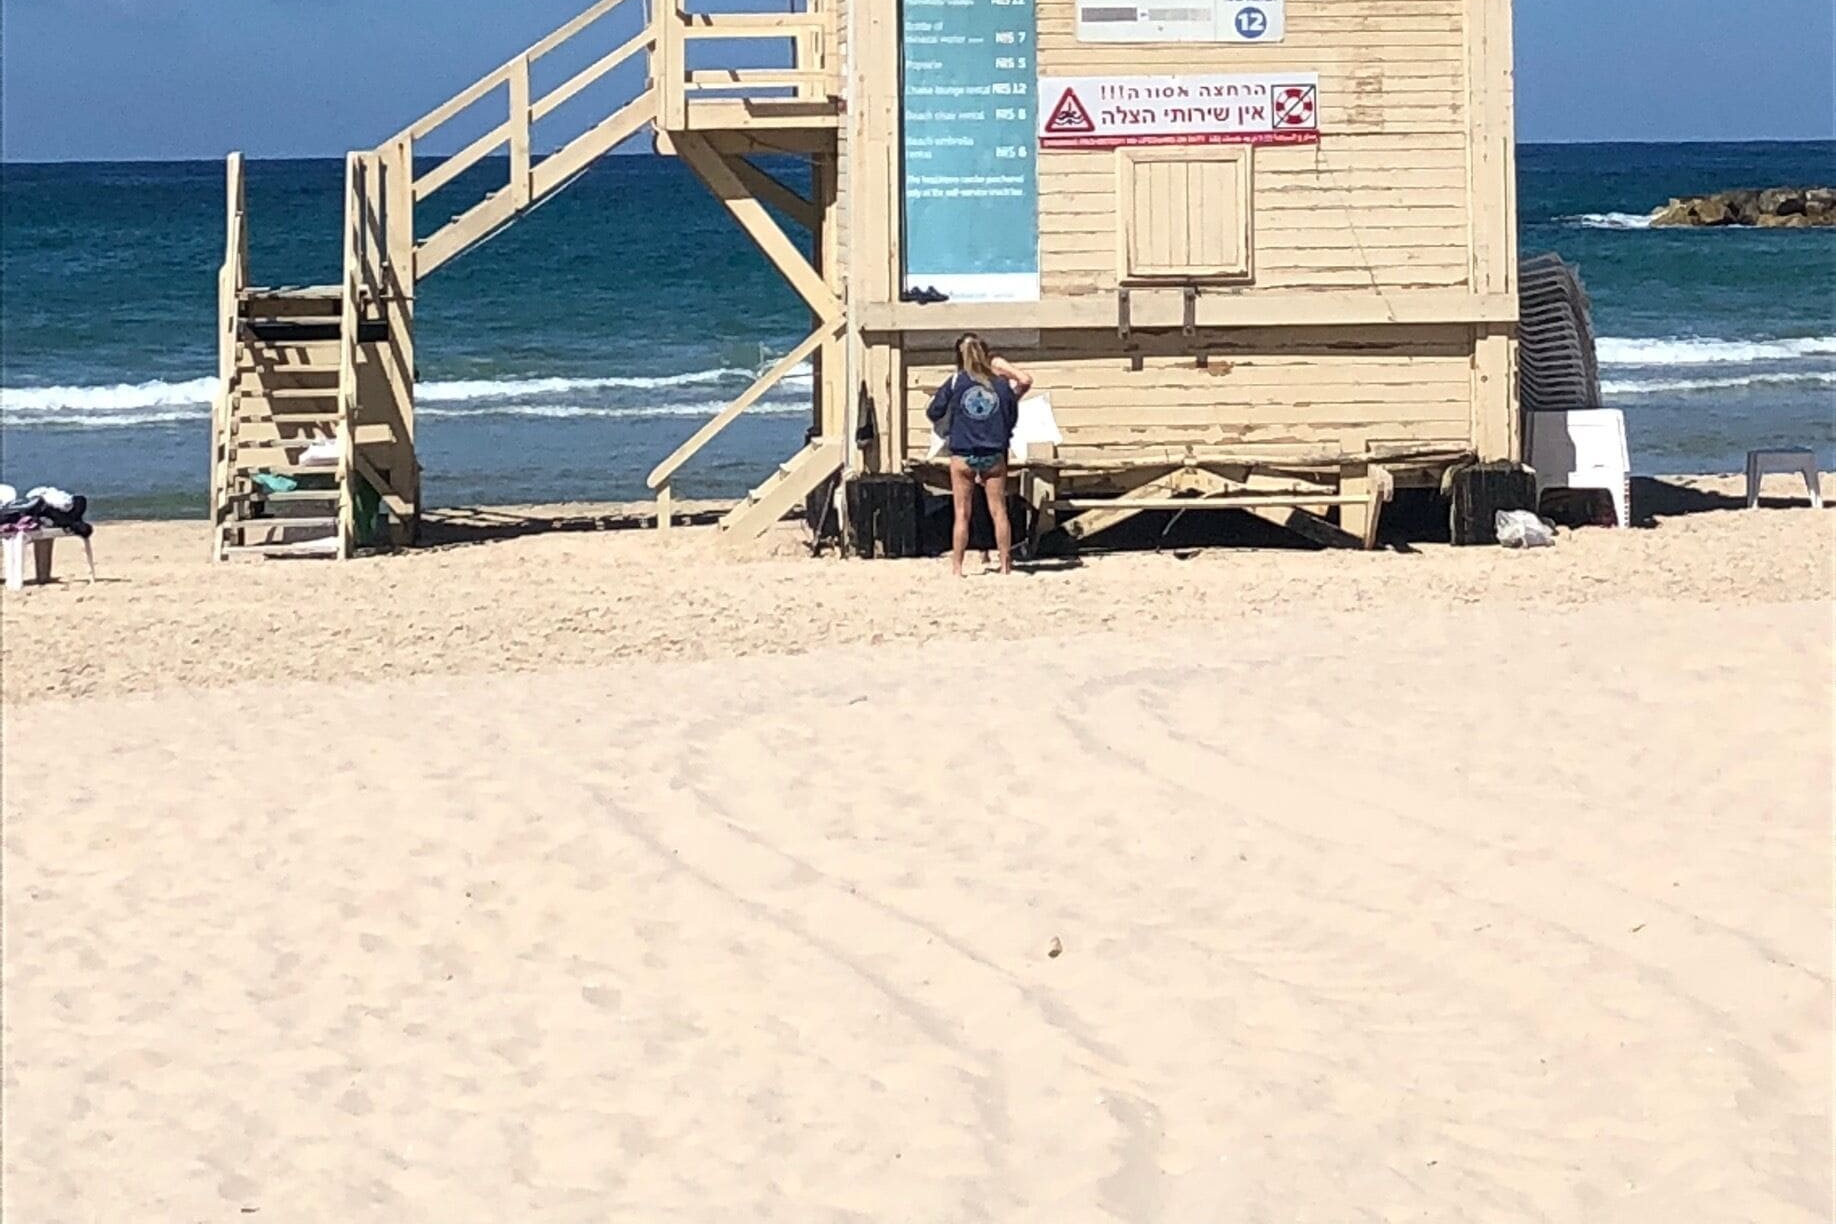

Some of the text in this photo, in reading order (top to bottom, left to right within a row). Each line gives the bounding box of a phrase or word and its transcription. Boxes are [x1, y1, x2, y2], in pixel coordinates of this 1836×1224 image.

[1238, 12, 1264, 31] 12
[1018, 31, 1026, 44] 7
[1017, 57, 1026, 69] 5
[1012, 83, 1027, 94] 12
[1199, 83, 1267, 98] הרחצה
[1101, 105, 1266, 126] אין שירותי הצלה
